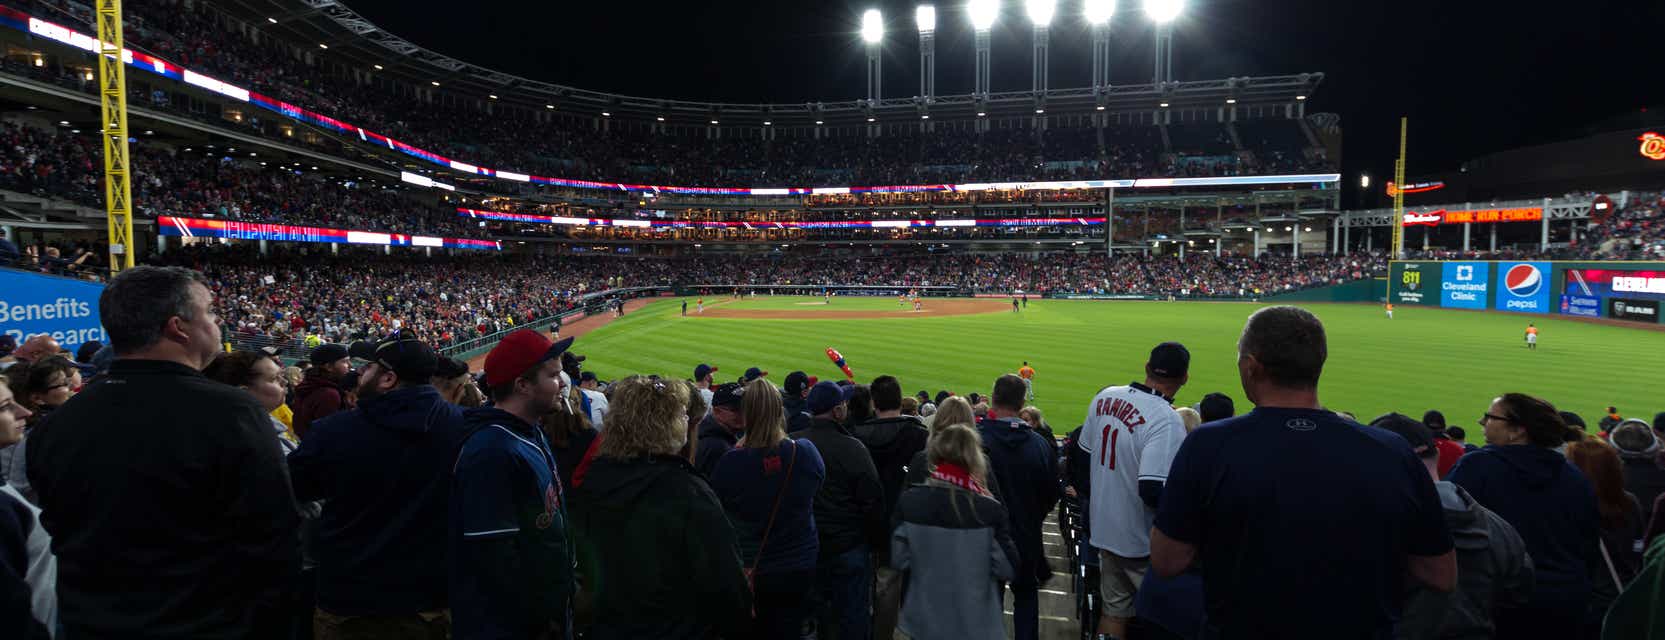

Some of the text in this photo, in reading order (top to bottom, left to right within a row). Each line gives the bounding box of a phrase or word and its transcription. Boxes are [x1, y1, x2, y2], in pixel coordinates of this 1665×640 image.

[1402, 271, 1420, 284] 811
[1442, 281, 1487, 291] Cleveland
[1450, 292, 1476, 301] Clinic
[1506, 298, 1537, 309] pepsi
[0, 297, 91, 323] Benefits
[5, 327, 106, 349] Rearc
[1096, 397, 1146, 434] RAMIREZ
[1101, 424, 1118, 470] 11
